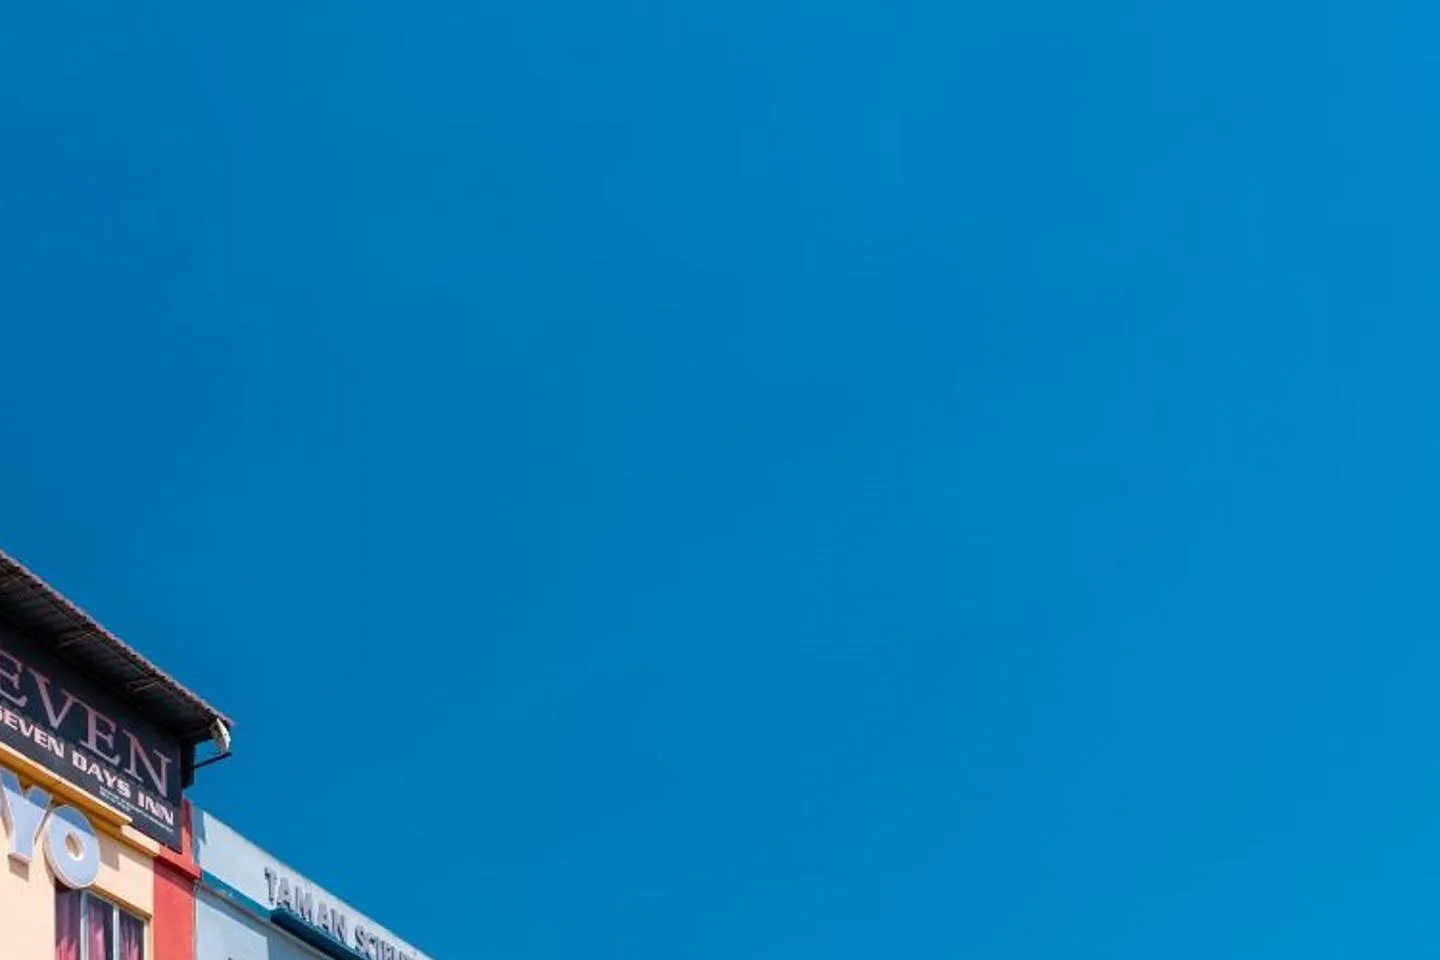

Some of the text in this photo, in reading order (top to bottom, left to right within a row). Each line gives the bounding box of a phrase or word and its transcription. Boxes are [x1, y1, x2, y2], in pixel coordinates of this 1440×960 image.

[71, 748, 131, 798] DAYS
[138, 791, 173, 825] INN
[264, 866, 346, 942] TAMAN
